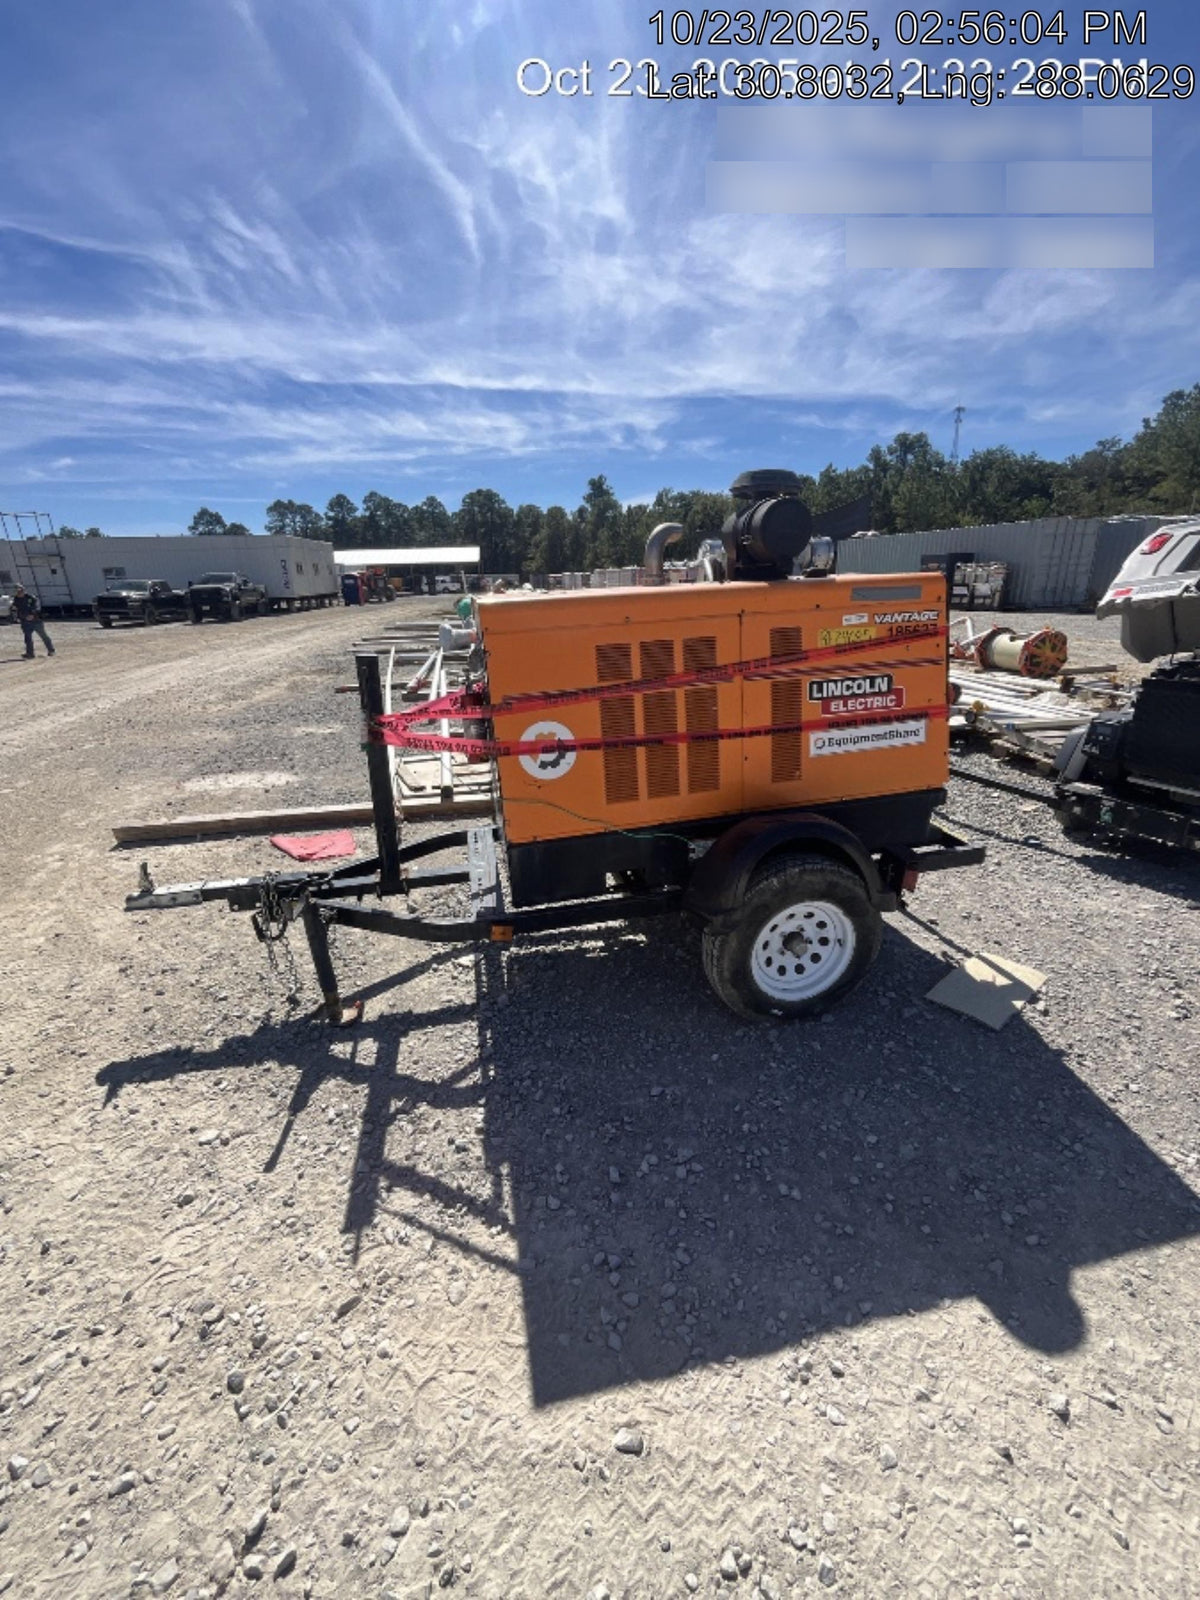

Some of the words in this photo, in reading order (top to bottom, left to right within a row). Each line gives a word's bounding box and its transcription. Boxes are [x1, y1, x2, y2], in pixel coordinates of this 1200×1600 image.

[874, 612, 938, 624] VANTAGE
[812, 676, 889, 699] LINCOLN
[830, 696, 897, 713] ELECTRIC
